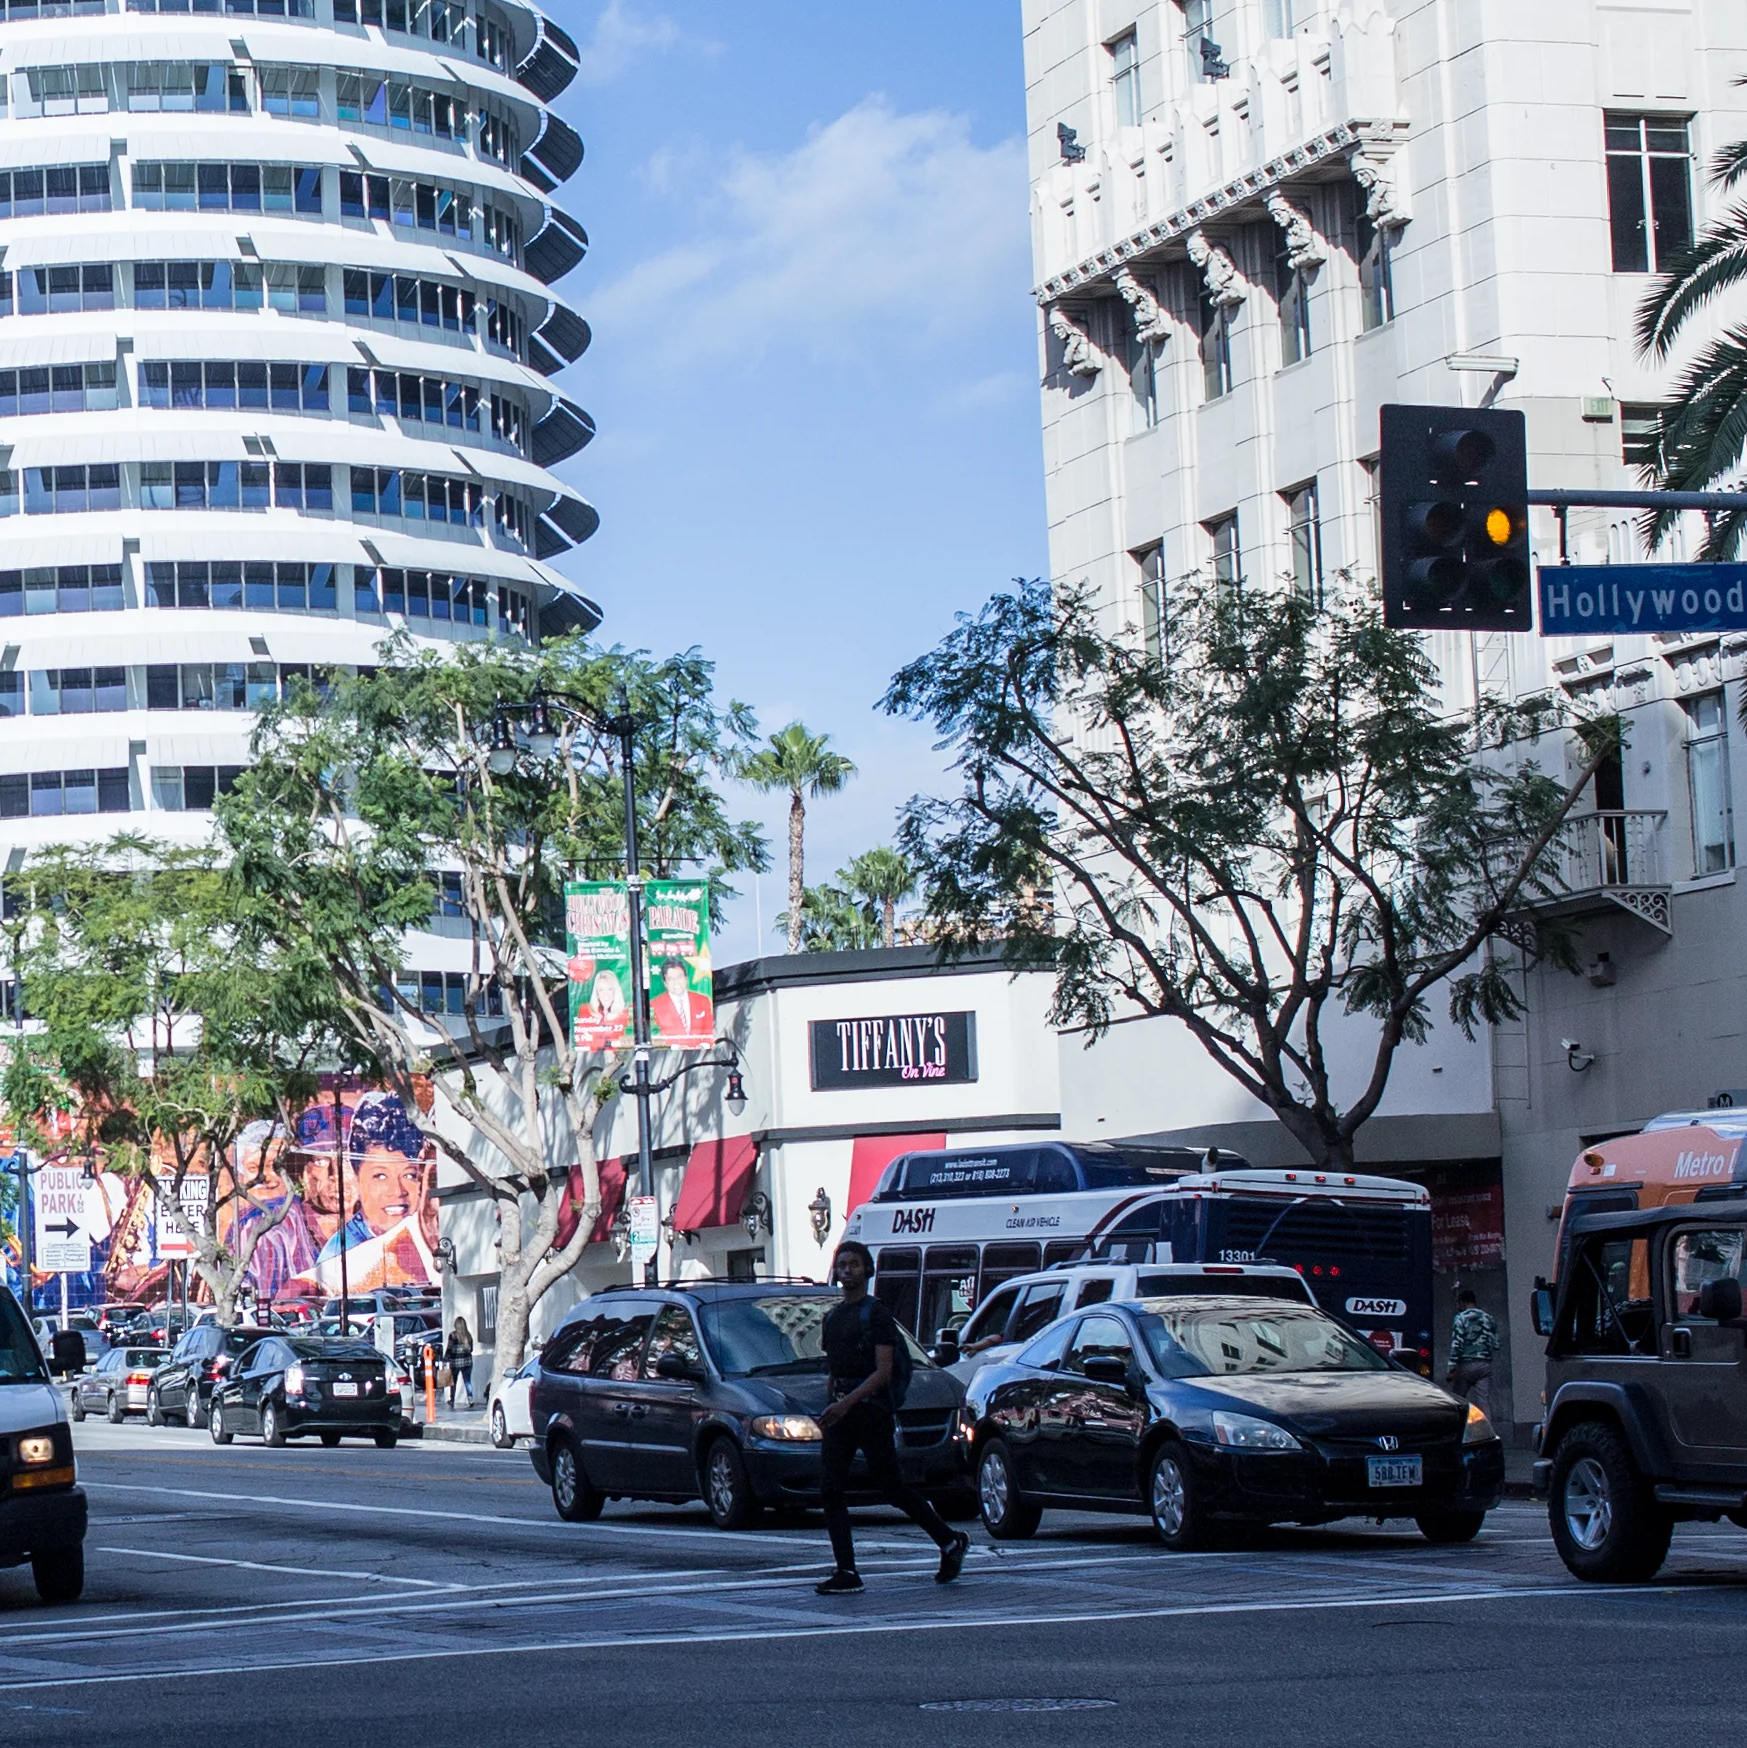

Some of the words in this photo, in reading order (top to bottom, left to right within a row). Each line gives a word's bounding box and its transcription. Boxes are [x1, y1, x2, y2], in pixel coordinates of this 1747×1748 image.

[1547, 580, 1745, 625] Hollywood
[648, 905, 700, 934] PARADE
[837, 1016, 946, 1071] TIFFANY'S
[901, 1065, 920, 1079] On
[922, 1062, 946, 1078] Vine
[1673, 1151, 1724, 1179] Metro
[40, 1172, 83, 1190] PUBLIC
[41, 1193, 77, 1214] PARK
[891, 1208, 936, 1234] DASH
[1006, 1218, 1025, 1228] CLEAN
[1025, 1217, 1036, 1228] AIR
[1036, 1216, 1060, 1227] VEHICLE
[1218, 1249, 1255, 1262] 13301
[1352, 1299, 1398, 1313] DASH
